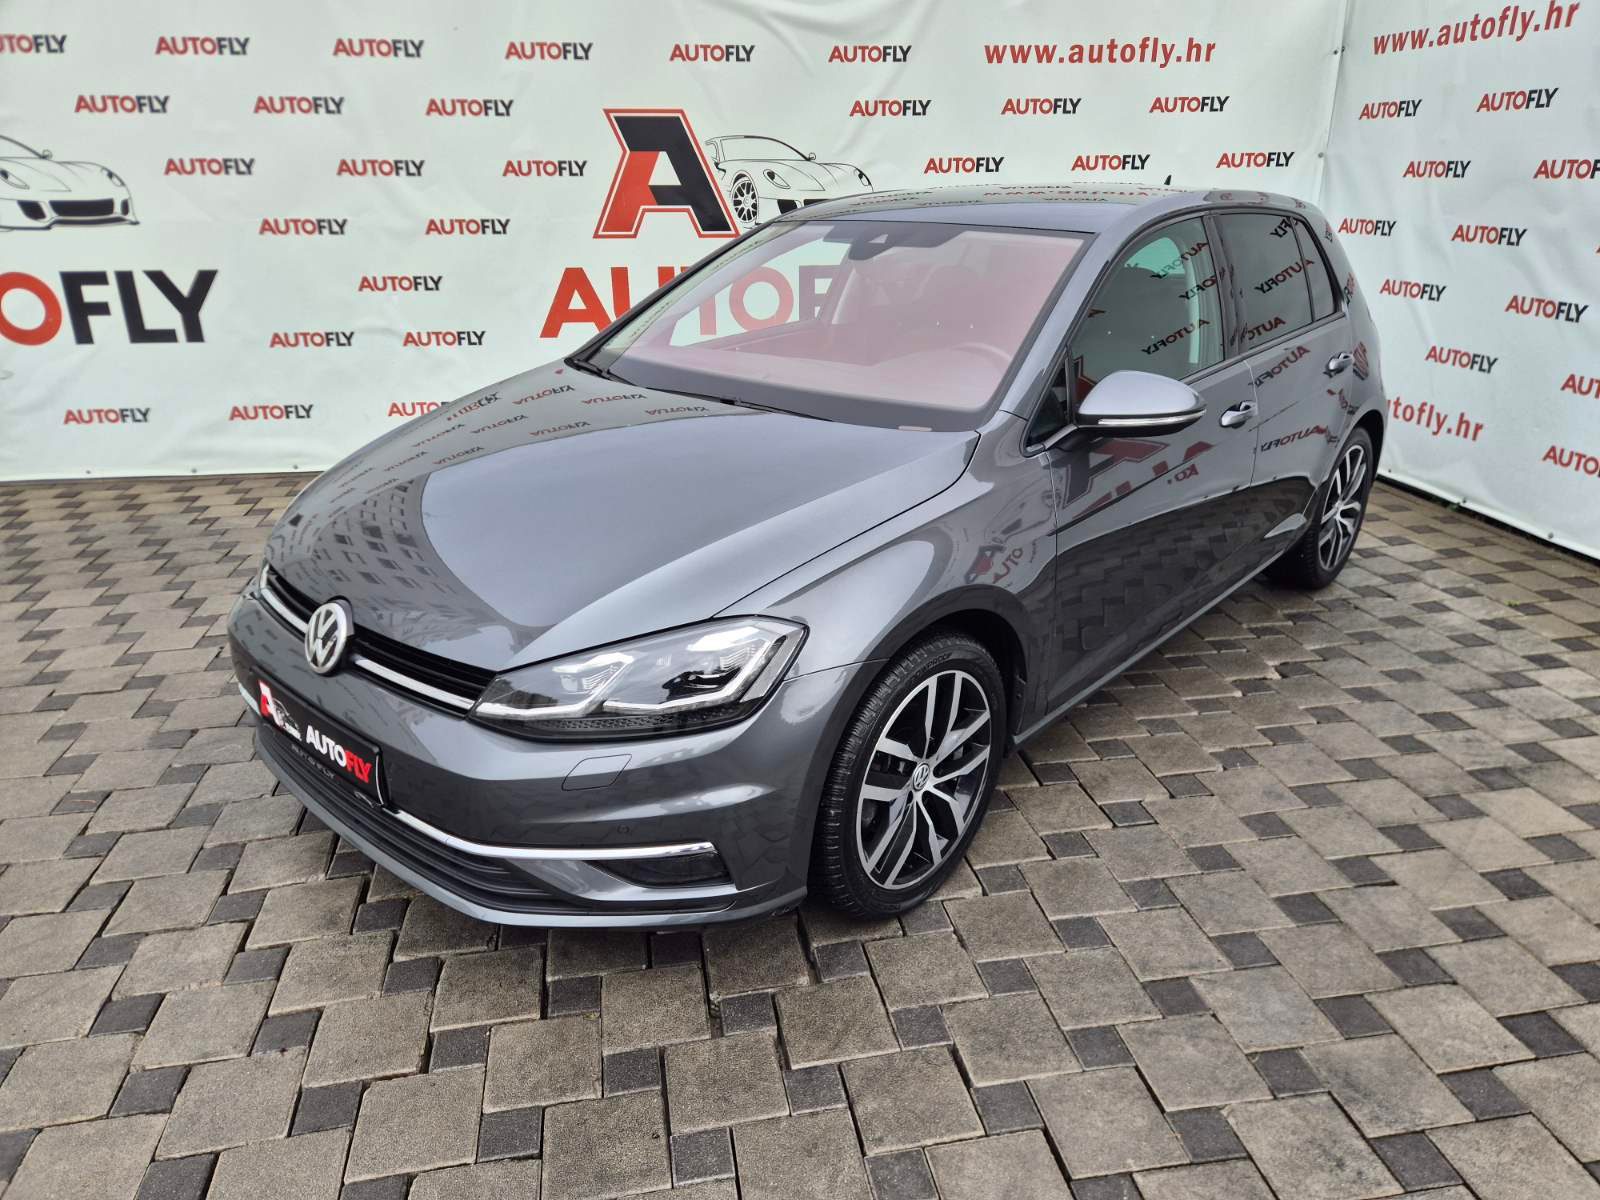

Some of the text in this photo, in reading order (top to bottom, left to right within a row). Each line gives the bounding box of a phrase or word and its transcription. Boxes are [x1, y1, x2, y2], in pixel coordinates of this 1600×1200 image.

[1374, 0, 1580, 55] www.autofly.hr
[0, 34, 67, 53] TOFLY
[155, 36, 250, 55] AUTOFLY
[333, 38, 424, 58] AUTOFLY
[505, 42, 593, 61] AUTOFLY
[984, 37, 1216, 68] www.autofly.hr
[669, 44, 755, 62] AUTOFLY
[828, 45, 912, 63] AUTOFLY
[74, 95, 170, 113] AUTOFLY
[254, 96, 344, 115] AUTOFLY
[426, 98, 514, 116] AUTOFLY
[849, 100, 932, 118] AUTOFLY
[1001, 98, 1082, 115] AUTOFLY
[1149, 96, 1230, 113] AUTOFLY
[1476, 88, 1559, 112] AUTOFLY
[1359, 99, 1422, 120] AUTOFLY
[164, 158, 255, 176] AUTOFLY
[336, 159, 425, 176] AUTOFLY
[502, 160, 587, 177] AUTOFLY
[924, 157, 1005, 174] AUTOFLY
[1071, 154, 1150, 171] AUTOFLY
[1216, 152, 1295, 168] AUTOFLY
[1402, 160, 1471, 178] AUTOFLY
[259, 218, 348, 235] AUTOFLY
[425, 218, 510, 235] AUTOFLY
[1338, 218, 1396, 237] AUTOFLY
[1451, 224, 1528, 246] AUTOFLY
[358, 276, 443, 292] AUTOFLY
[1379, 279, 1446, 302] AUTOFLY
[1505, 295, 1589, 324] AUTOFLY
[269, 331, 355, 348] AUTOFLY
[403, 331, 486, 347] AUTOFLY
[1425, 345, 1498, 374] AUTOFLY
[64, 408, 150, 425] AUTOFLY
[229, 404, 314, 421] AUTOFLY
[388, 402, 450, 417] AUTO
[1387, 395, 1483, 442] tofly.hr
[1542, 445, 1600, 478] AUTO
[306, 725, 373, 784] AUTOFLY
